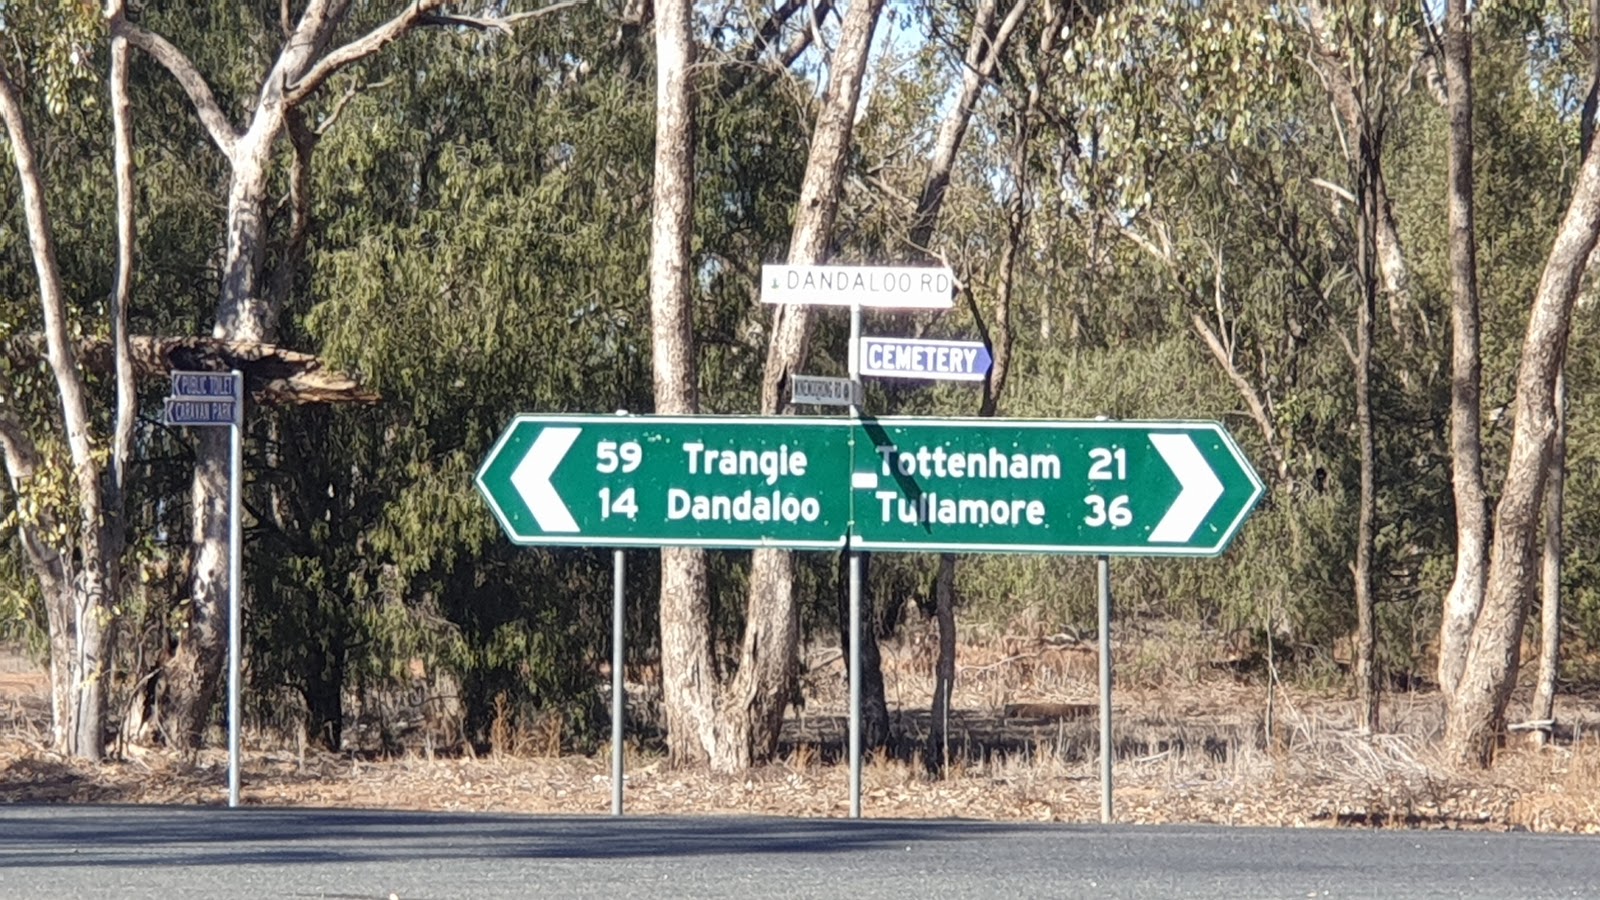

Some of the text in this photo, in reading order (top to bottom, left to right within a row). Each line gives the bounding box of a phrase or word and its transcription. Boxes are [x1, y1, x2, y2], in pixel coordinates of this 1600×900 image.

[787, 270, 949, 293] DANDALOO RD
[868, 344, 978, 373] CEMETERY
[181, 375, 207, 395] PUBLIC
[175, 402, 210, 421] CARAVAN
[596, 441, 807, 486] 59 Trangie
[880, 445, 1126, 480] Tottenham 21
[598, 487, 820, 522] 14 Dandaloo
[875, 491, 1133, 527] Tullamore 36
